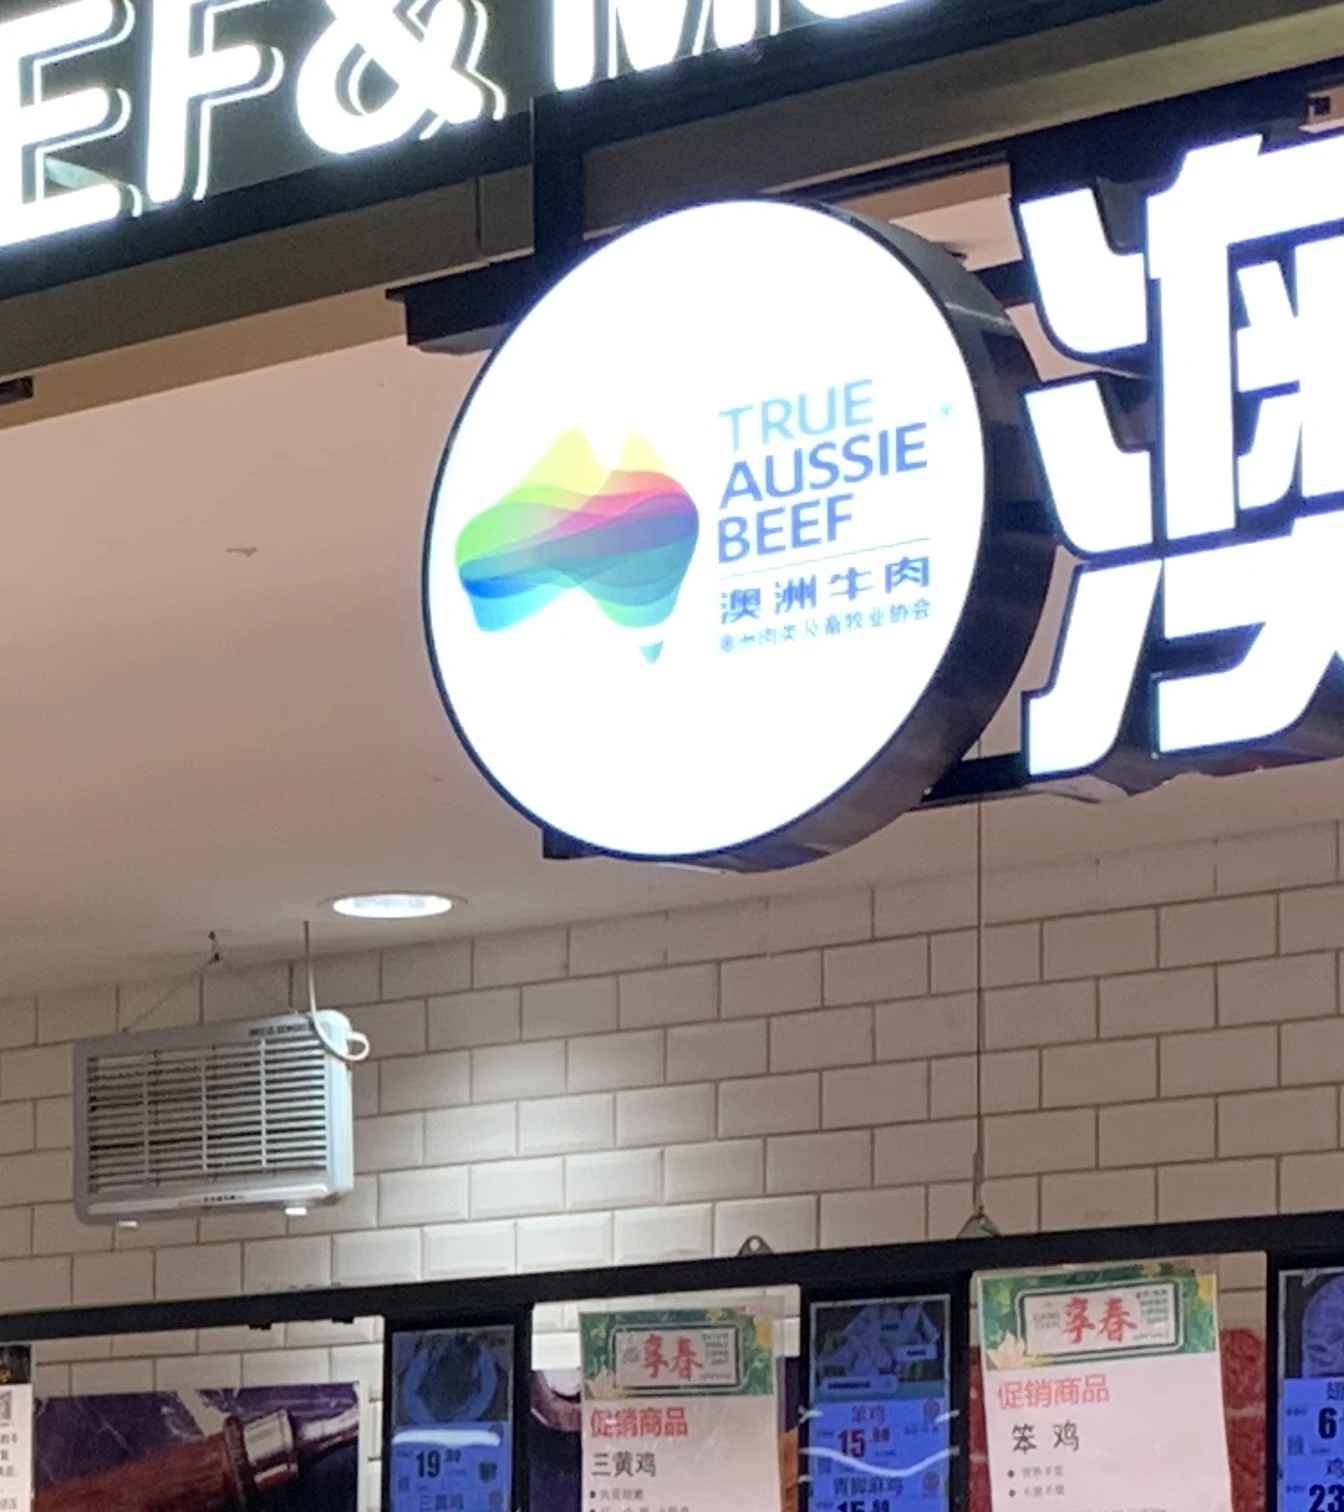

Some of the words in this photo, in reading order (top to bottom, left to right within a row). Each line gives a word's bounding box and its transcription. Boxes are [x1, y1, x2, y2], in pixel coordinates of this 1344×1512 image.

[718, 378, 873, 453] TRUE
[718, 421, 928, 511] AUSSIE
[718, 492, 855, 564] BEEF
[720, 556, 930, 625] 澳洲牛肉
[998, 1373, 1110, 1411] 促销商品
[590, 1405, 689, 1438] 促销商品
[1012, 1423, 1038, 1454] 笨
[1052, 1419, 1080, 1452] 鸡
[591, 1450, 657, 1478] 三黄鸡
